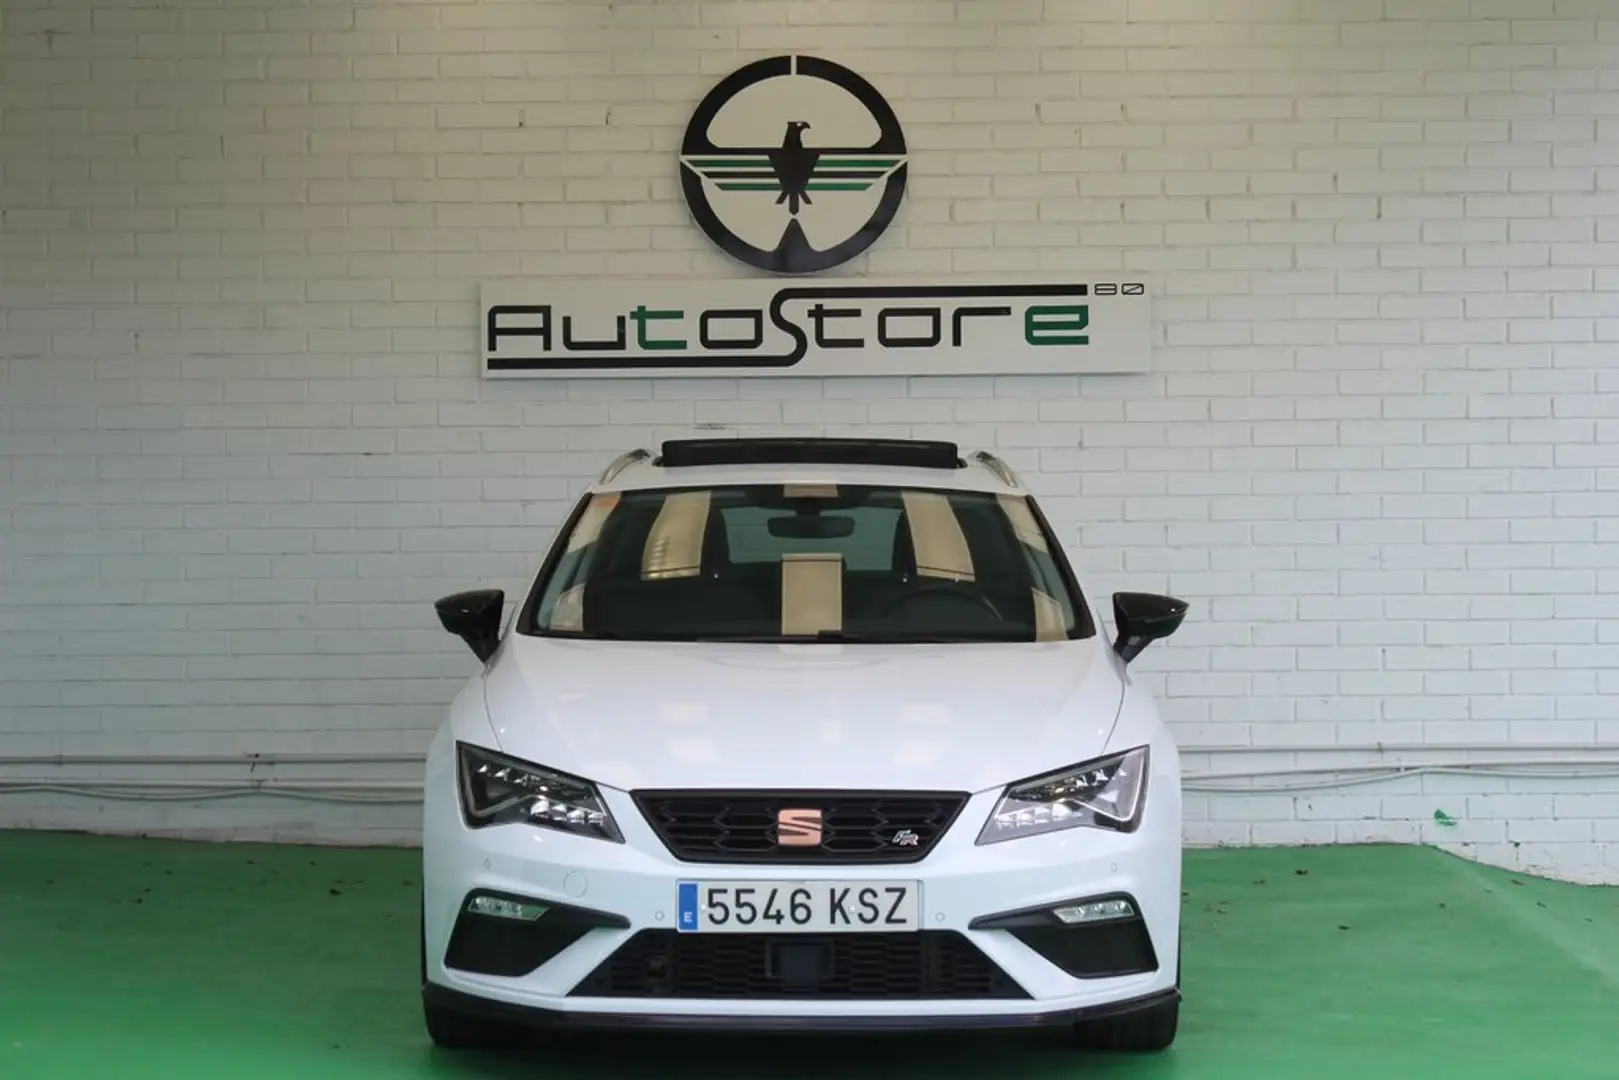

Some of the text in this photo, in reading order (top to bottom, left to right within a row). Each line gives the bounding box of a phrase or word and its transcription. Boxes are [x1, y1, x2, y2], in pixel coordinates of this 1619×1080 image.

[487, 283, 1145, 369] AutoStore 80
[707, 887, 908, 925] 5546 KSZ
